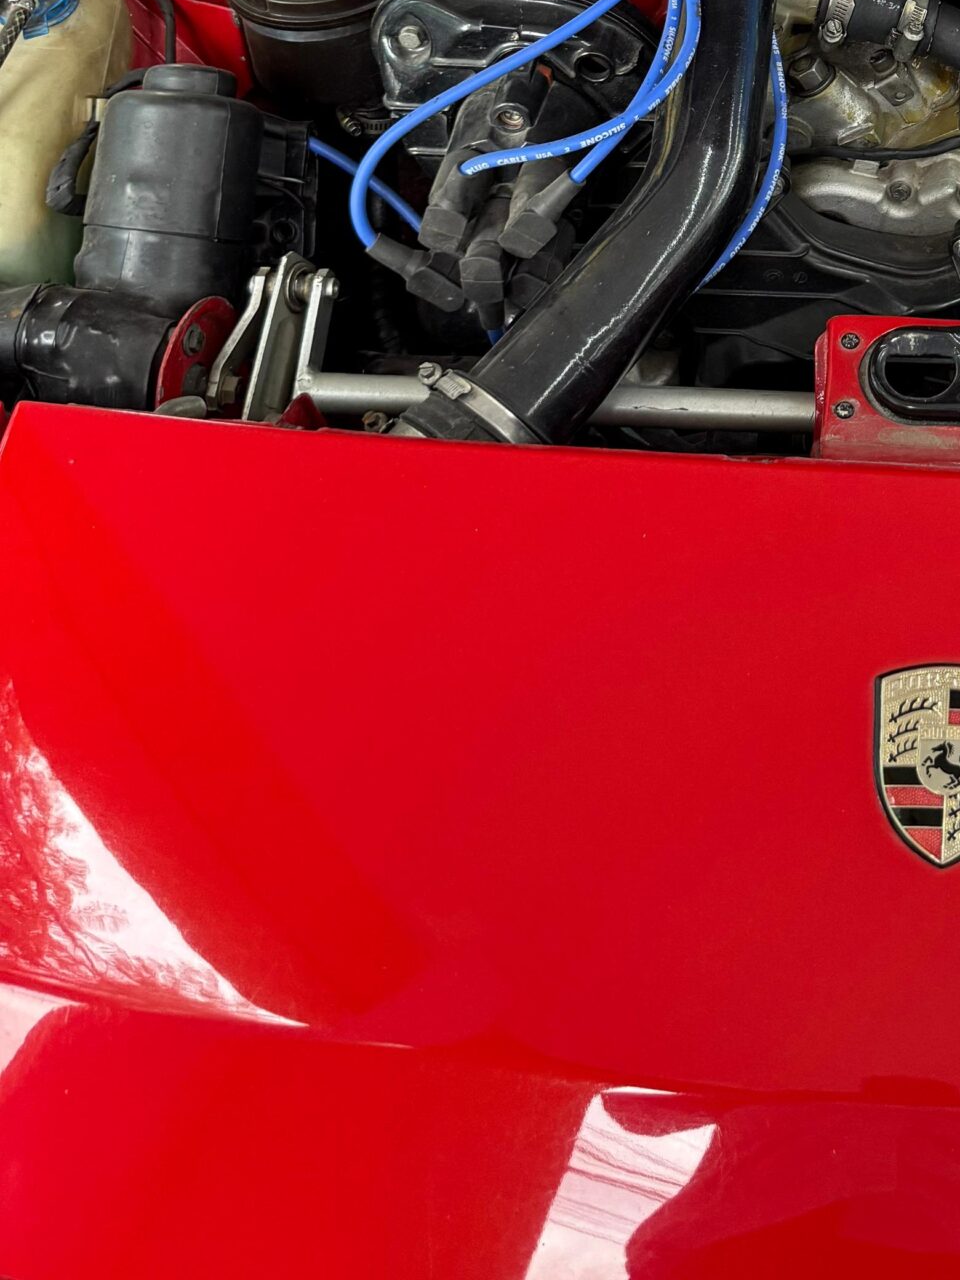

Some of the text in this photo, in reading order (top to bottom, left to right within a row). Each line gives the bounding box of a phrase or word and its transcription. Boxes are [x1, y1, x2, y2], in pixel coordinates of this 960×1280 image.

[662, 26, 677, 63] SILICONE
[580, 122, 626, 148] SILICONE
[496, 155, 529, 167] CABLE
[535, 151, 554, 160] USA
